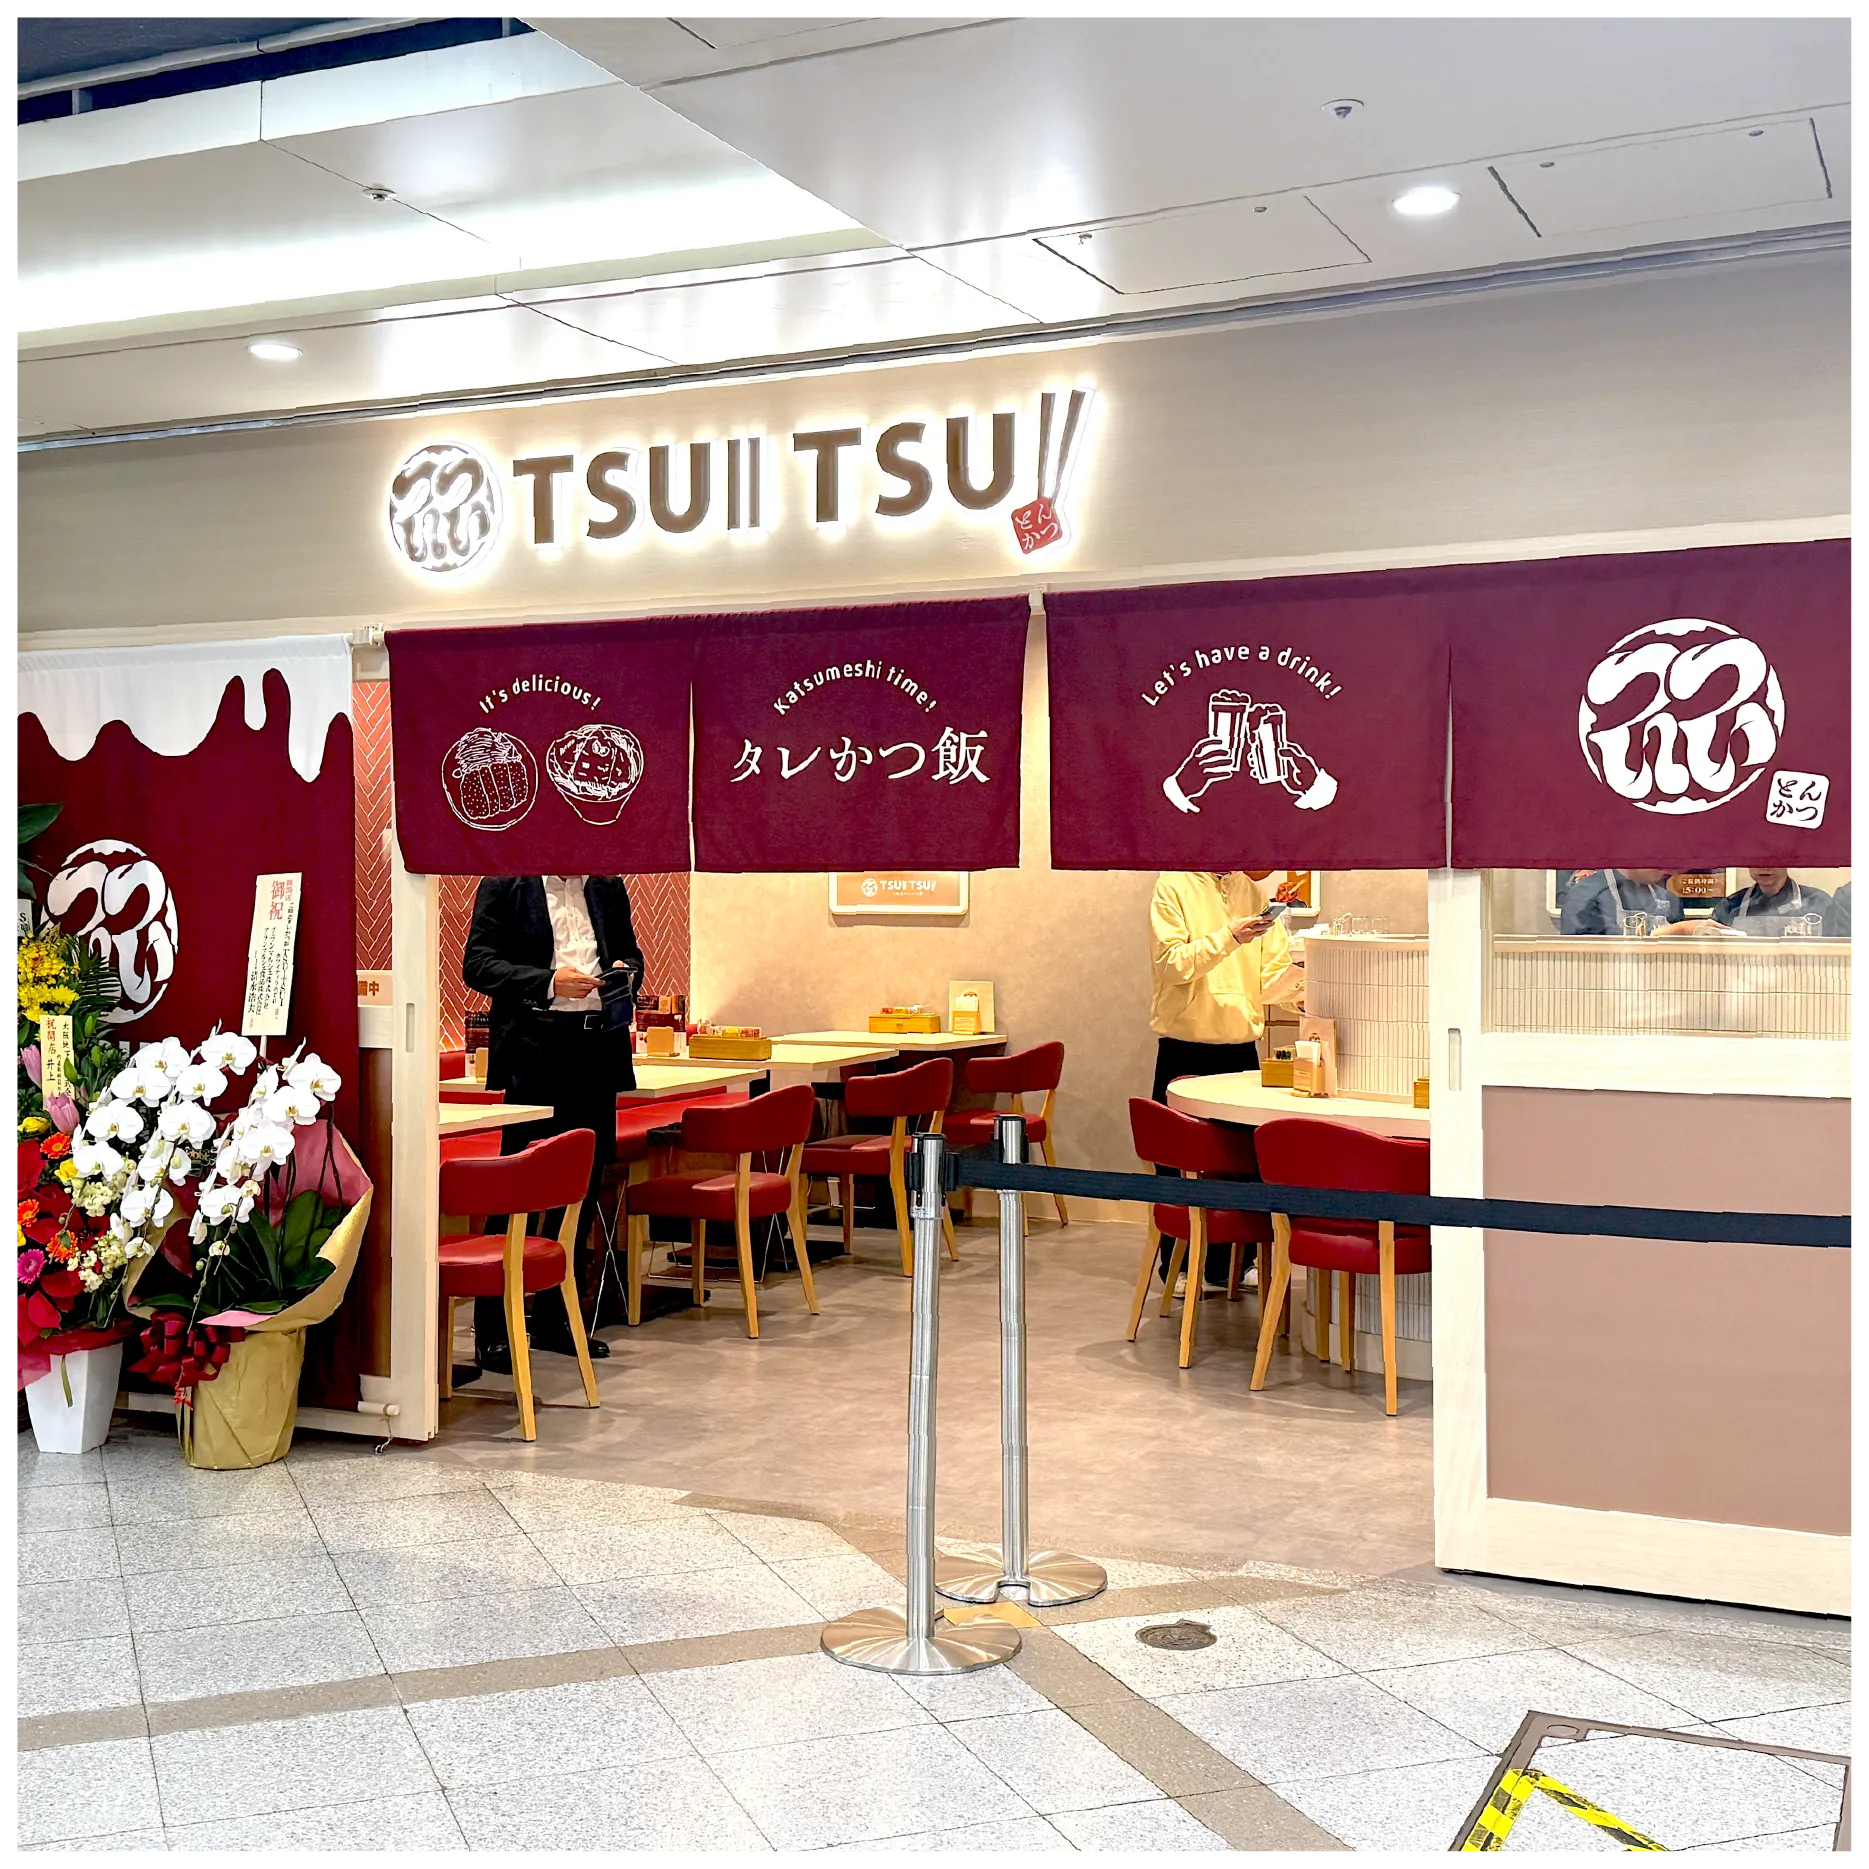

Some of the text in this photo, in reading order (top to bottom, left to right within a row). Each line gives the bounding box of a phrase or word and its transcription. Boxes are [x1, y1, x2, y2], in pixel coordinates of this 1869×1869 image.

[479, 674, 601, 714] It's delicious!
[773, 660, 937, 715] Katsumeshi time!
[1141, 645, 1342, 706] Let's have a drink!
[731, 727, 991, 785] タレかつ飯
[268, 880, 286, 921] 御祝
[45, 1017, 57, 1055] 祝開店
[46, 1058, 56, 1082] 井上
